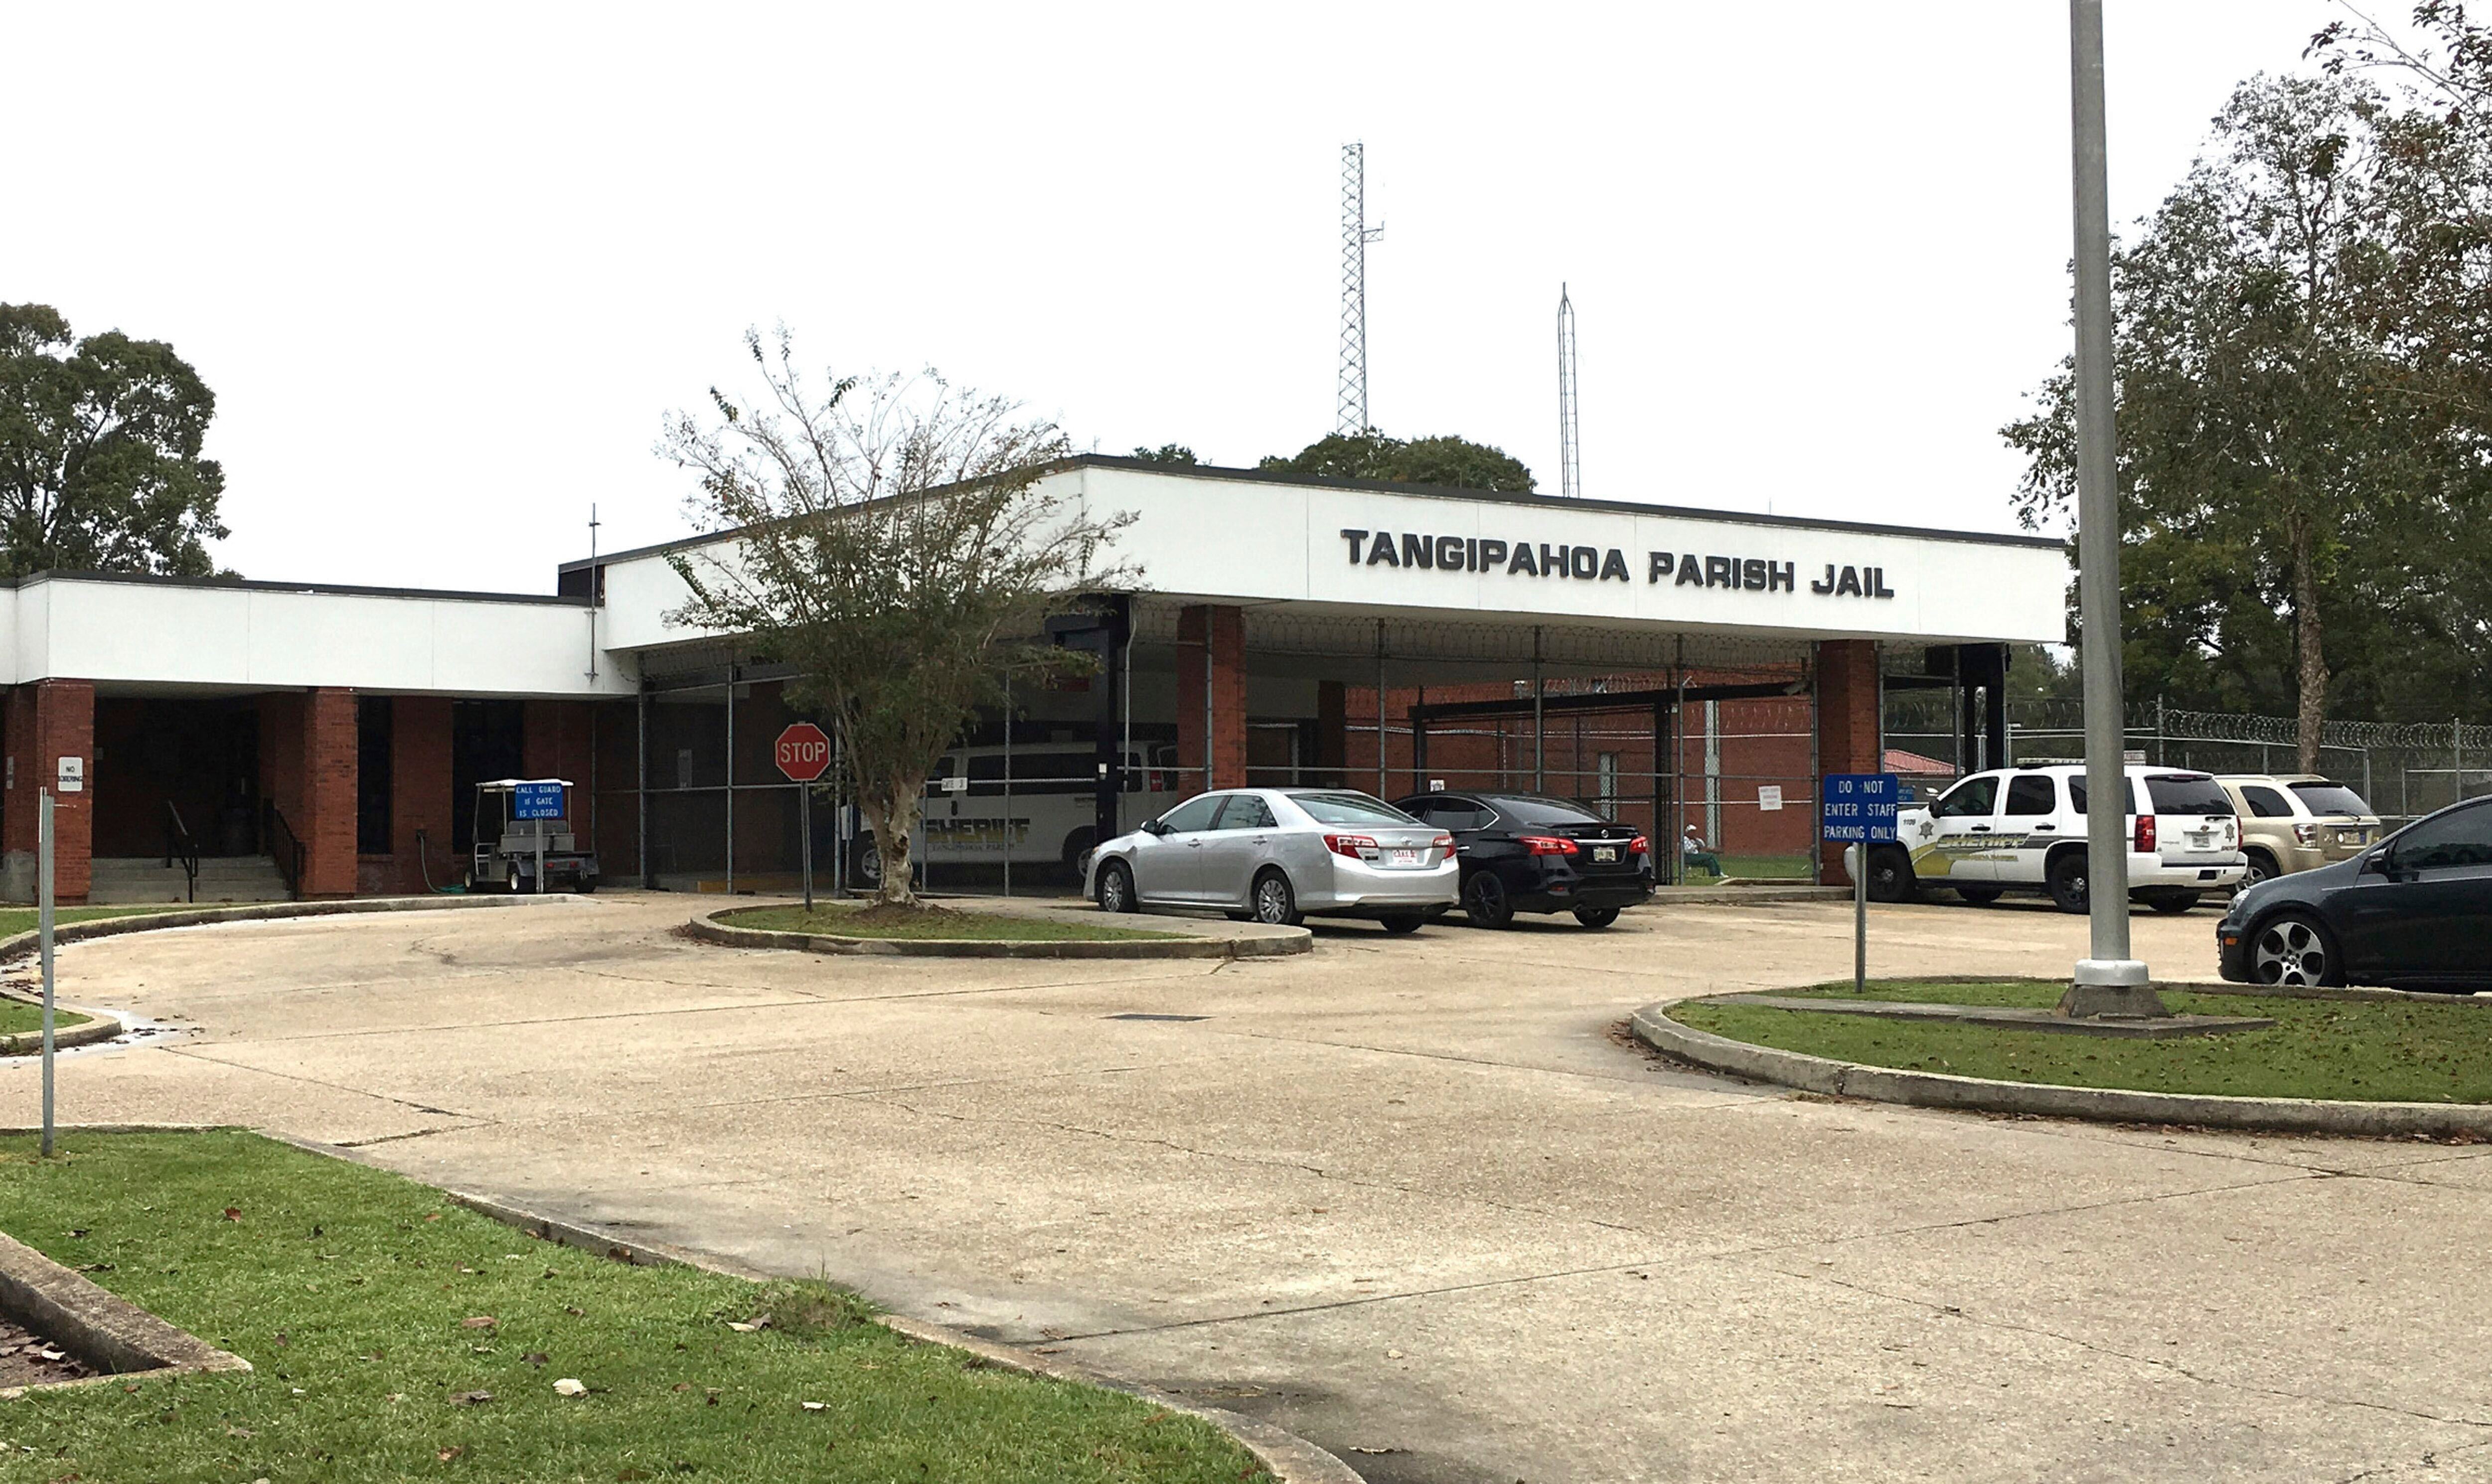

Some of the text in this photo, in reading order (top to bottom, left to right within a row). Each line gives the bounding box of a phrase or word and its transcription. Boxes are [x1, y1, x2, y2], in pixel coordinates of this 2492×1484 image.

[1340, 529, 1894, 598] TANGIPAHOA PARISH JAIL
[780, 742, 826, 763] STOP
[1838, 780, 1884, 794] DO NOT
[1825, 803, 1896, 816] ENTER STAFF
[1824, 825, 1896, 839] PARKING ONLY
[1936, 832, 2031, 849] SHERIFF
